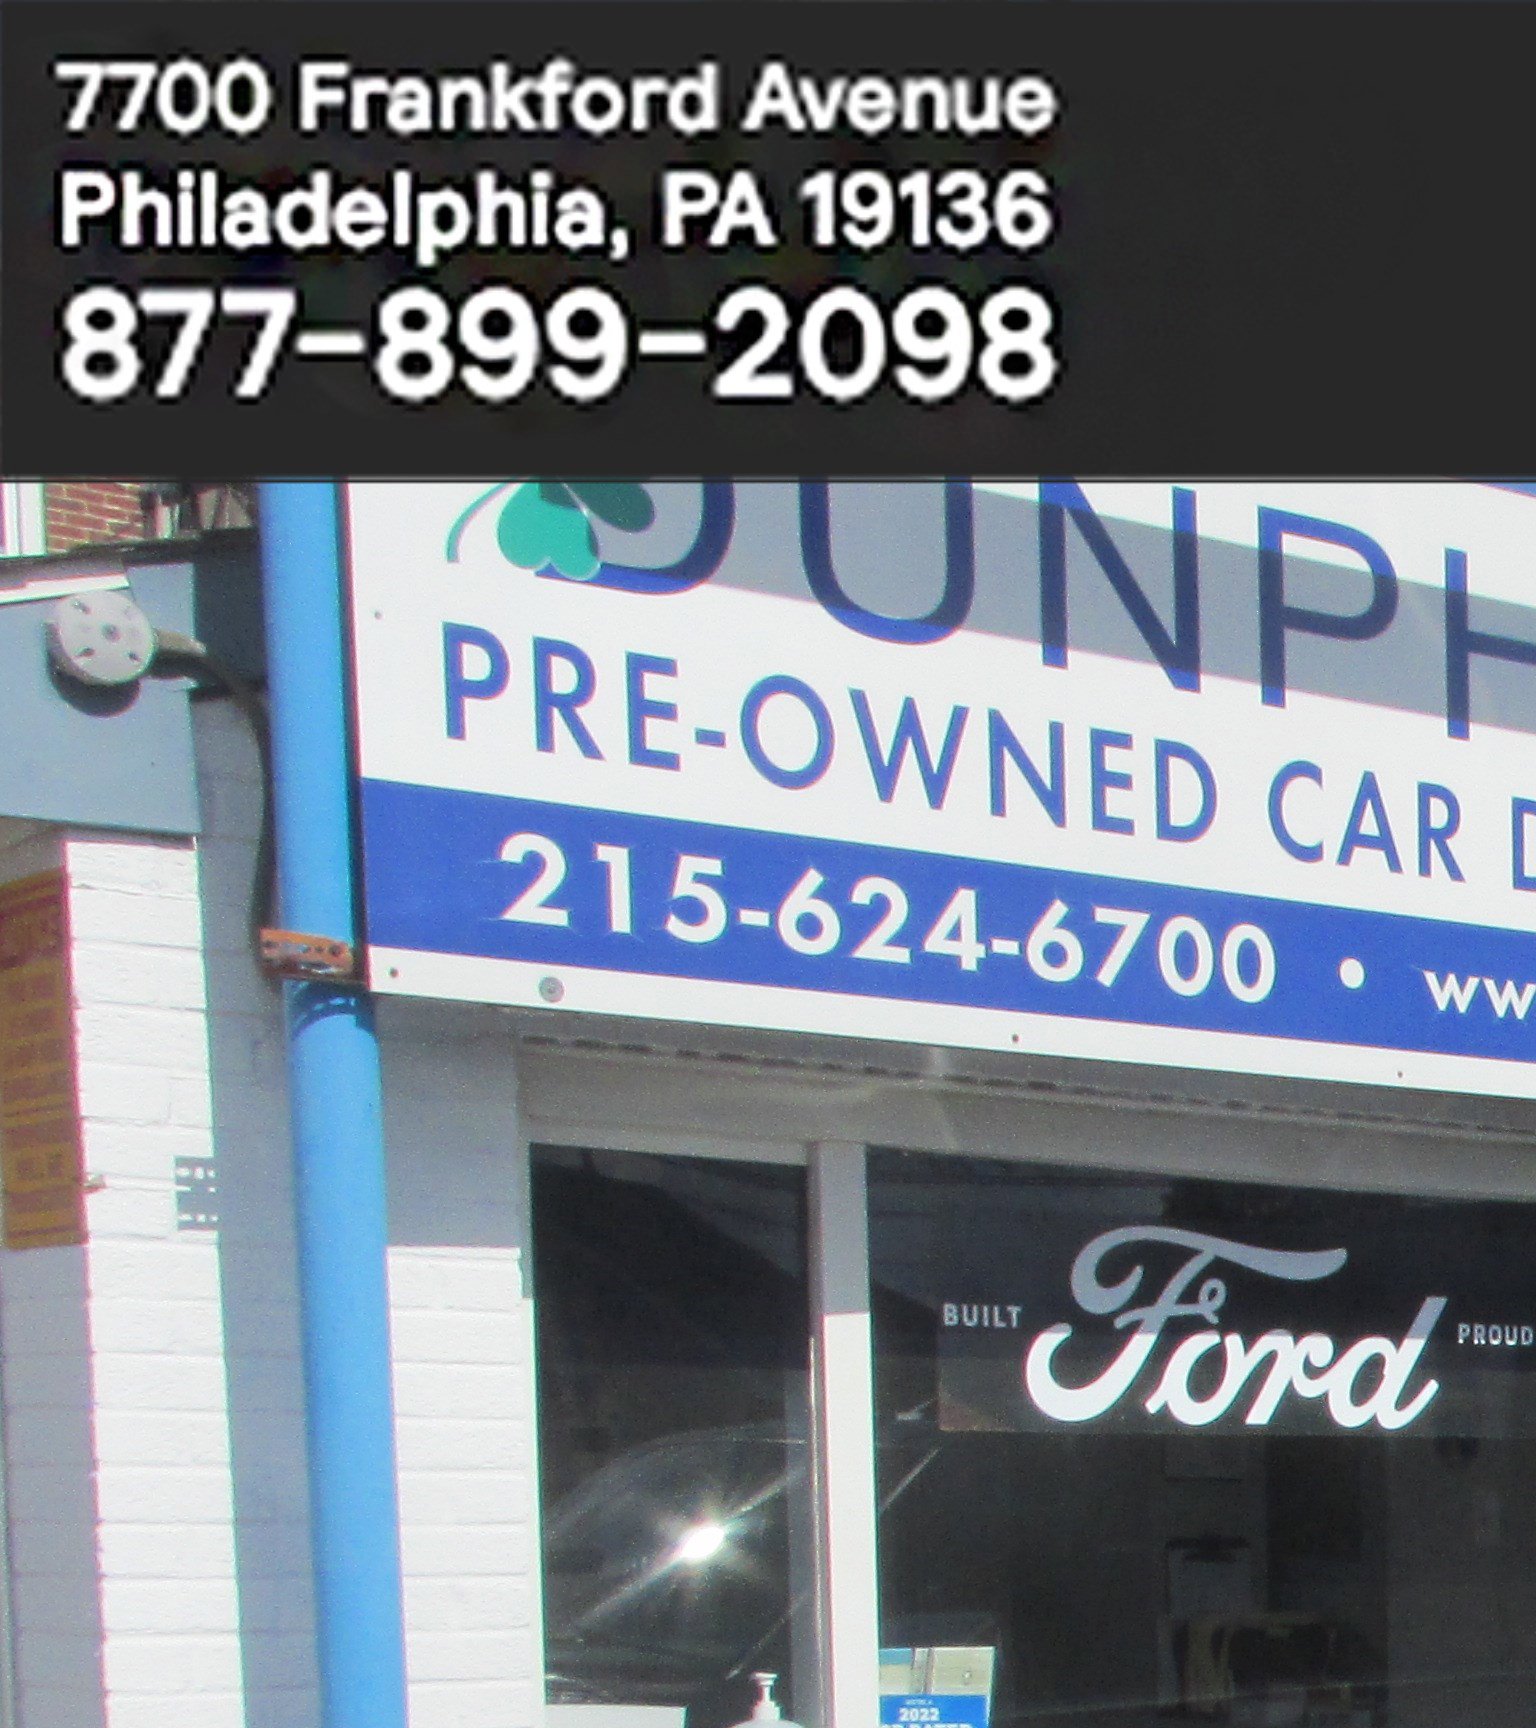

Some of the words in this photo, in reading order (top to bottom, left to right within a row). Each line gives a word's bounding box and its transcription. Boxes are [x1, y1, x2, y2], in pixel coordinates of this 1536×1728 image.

[441, 621, 1218, 845] PRE-OWNED
[1268, 760, 1467, 884] CAR
[497, 831, 1278, 1004] 215-624-6700
[941, 1302, 1024, 1329] BUILT
[1024, 1224, 1449, 1430] Ford
[1456, 1322, 1536, 1347] PROUD
[898, 1707, 940, 1722] 2022
